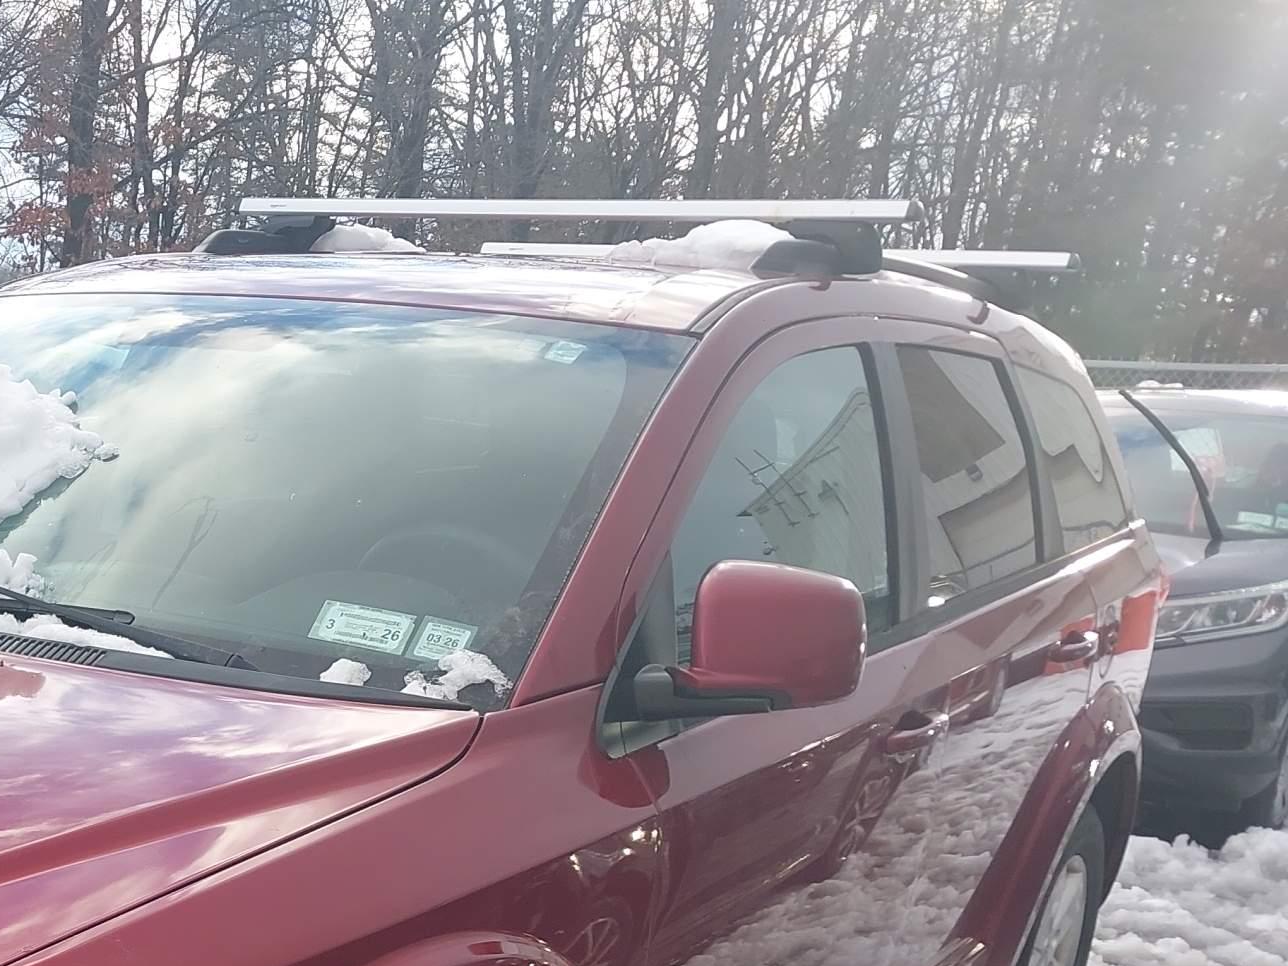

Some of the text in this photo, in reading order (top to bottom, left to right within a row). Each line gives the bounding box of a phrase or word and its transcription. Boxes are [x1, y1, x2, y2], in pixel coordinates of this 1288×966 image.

[326, 618, 336, 630] 3
[380, 628, 401, 642] 26
[426, 633, 442, 644] 03
[444, 637, 460, 648] 26
